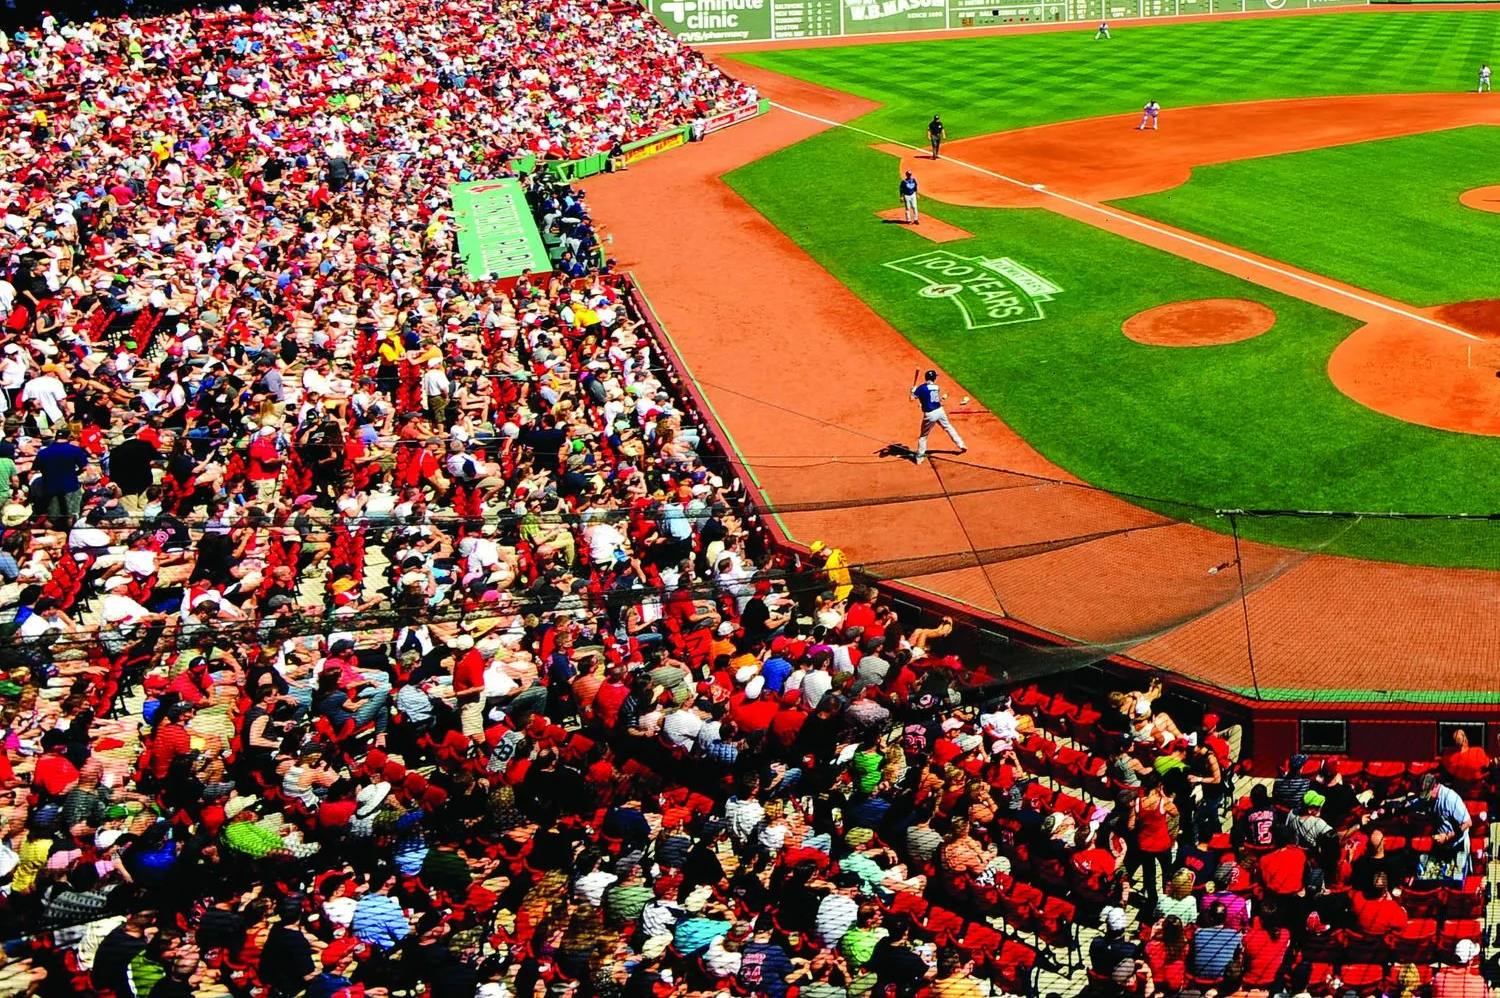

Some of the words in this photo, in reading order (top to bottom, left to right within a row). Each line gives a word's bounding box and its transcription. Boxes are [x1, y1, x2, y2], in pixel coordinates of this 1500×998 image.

[687, 11, 738, 29] clinic
[677, 31, 749, 42] CVS/pharmacy
[914, 257, 974, 276] 100
[961, 272, 1024, 319] YEARS
